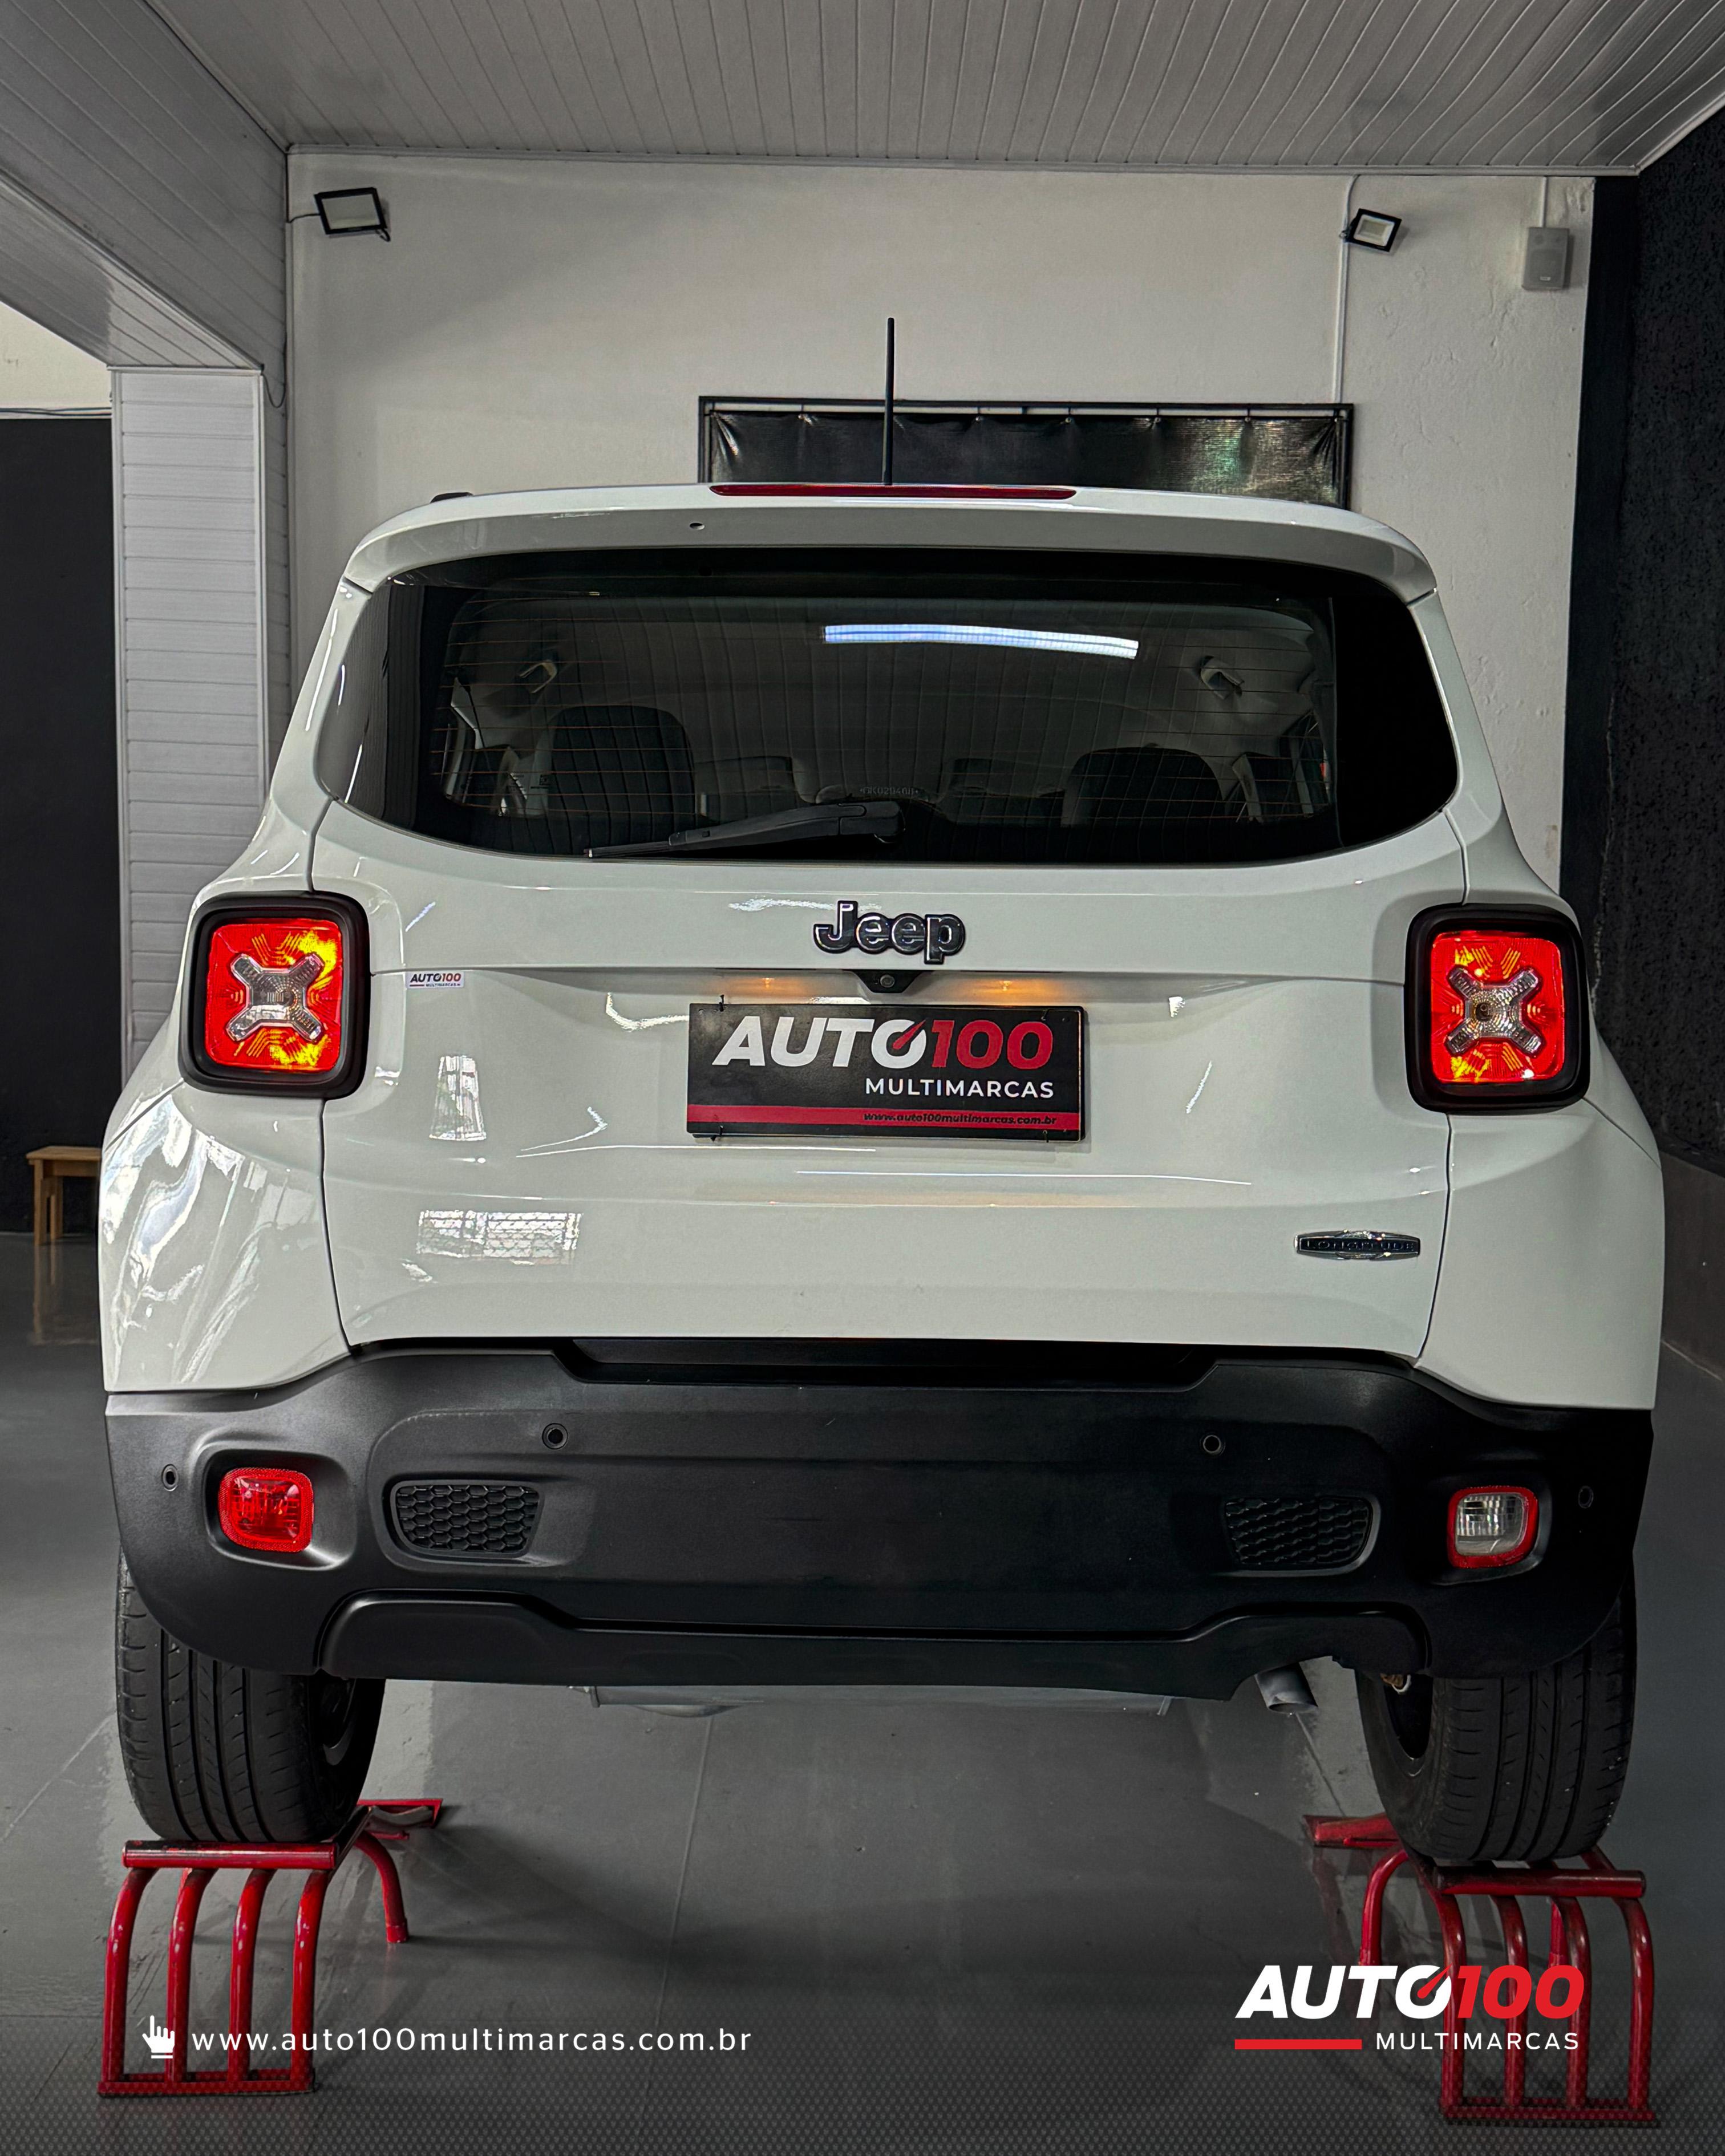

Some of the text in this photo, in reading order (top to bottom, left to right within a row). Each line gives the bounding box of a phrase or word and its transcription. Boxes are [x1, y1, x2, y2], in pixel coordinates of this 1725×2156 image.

[813, 901, 965, 964] Jeep
[410, 973, 461, 982] AUTO100
[712, 1016, 1054, 1069] AUTO100
[865, 1078, 1054, 1099] MULTIMARCAS
[864, 1113, 1057, 1125] www.auto100multimarcas.com.br
